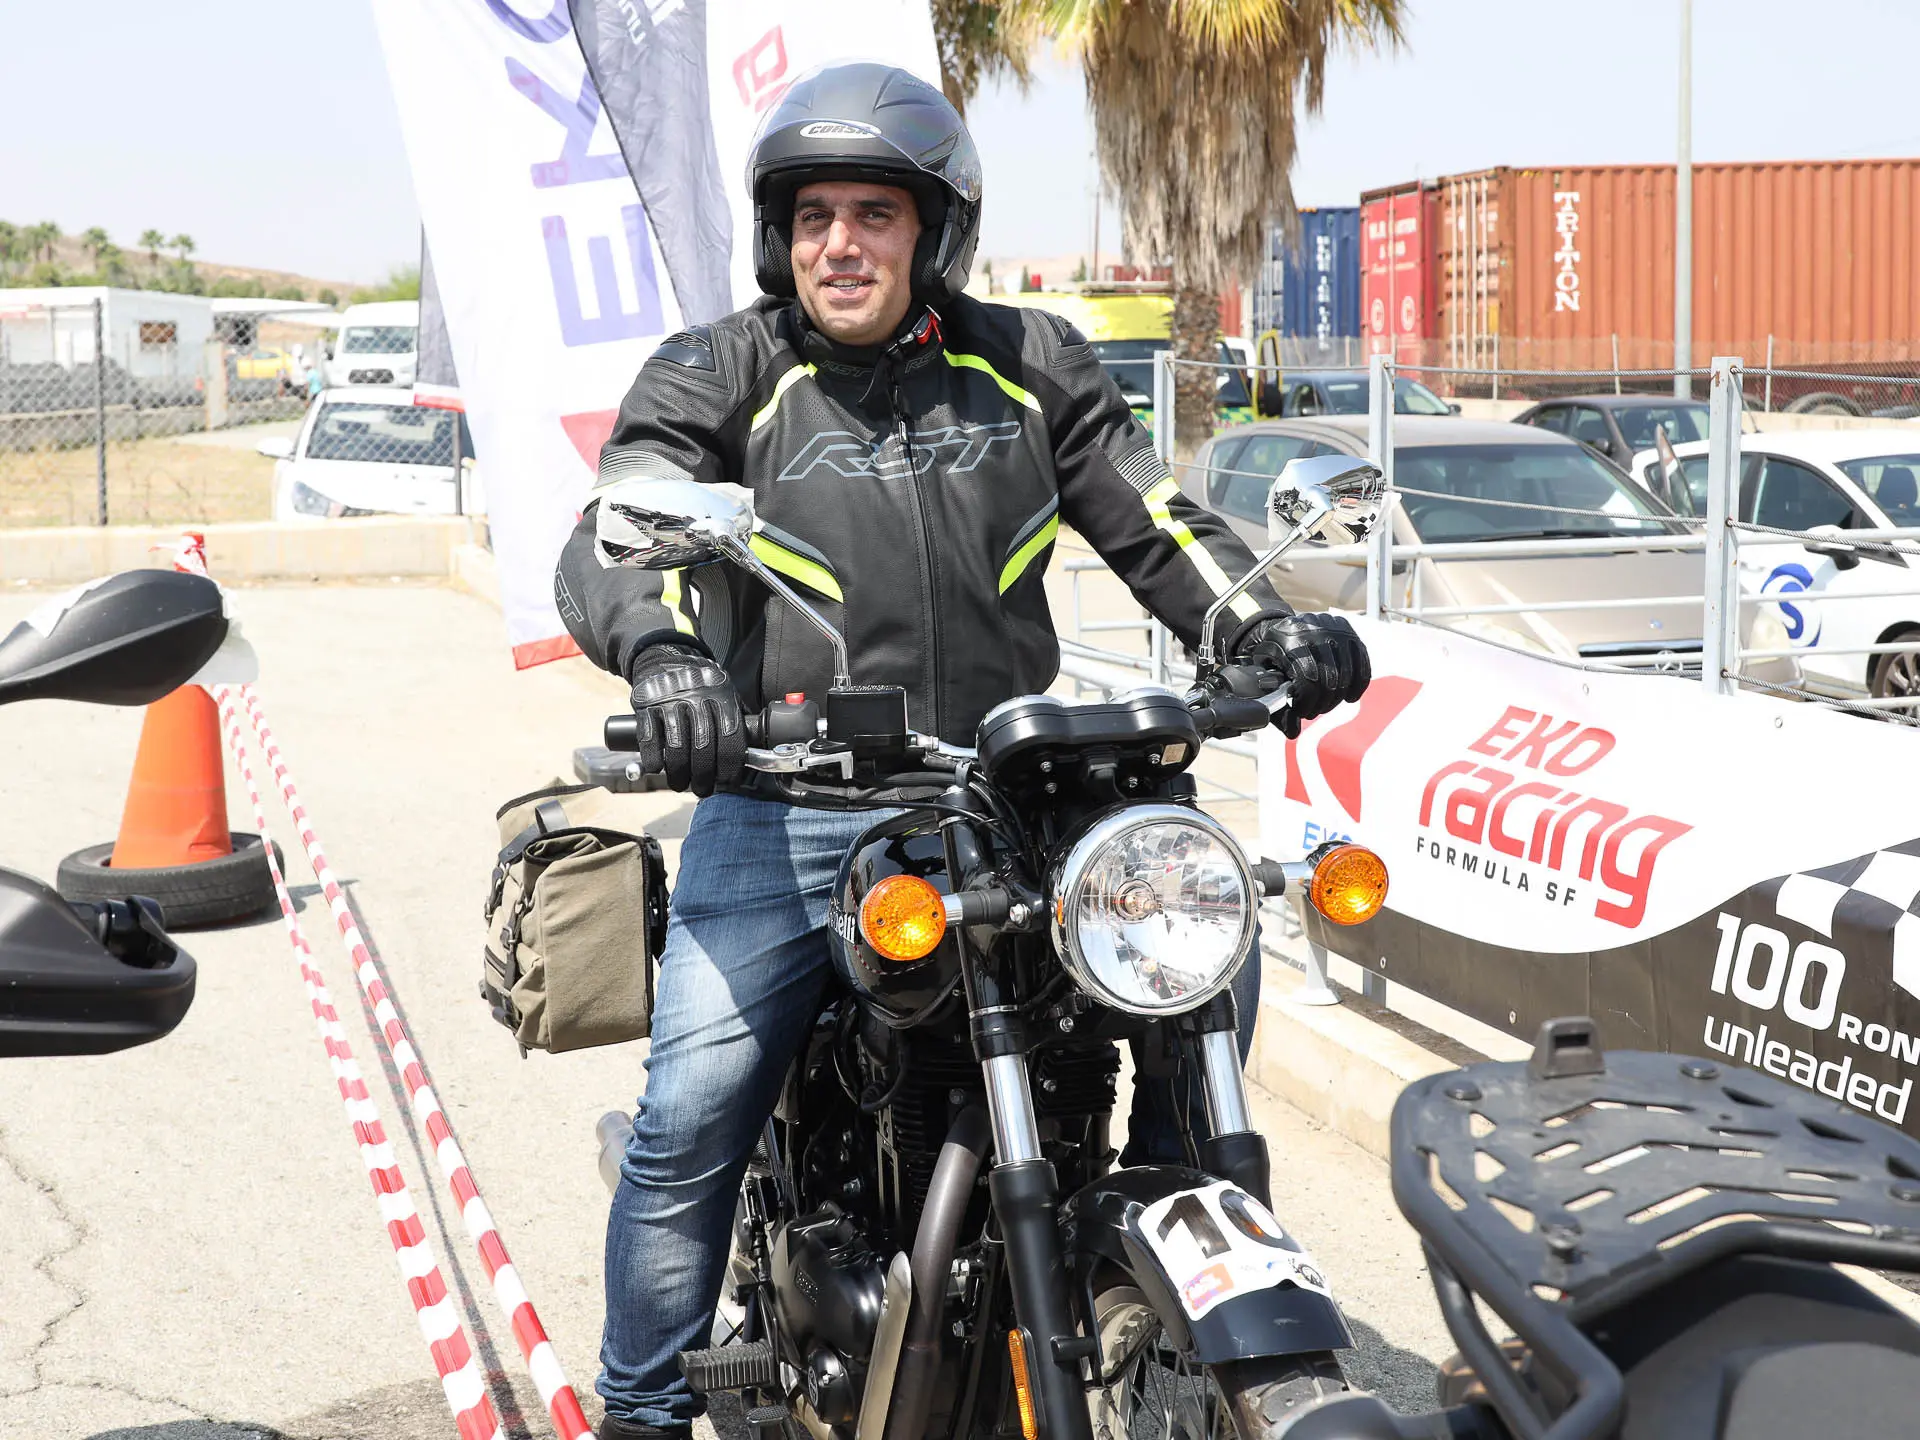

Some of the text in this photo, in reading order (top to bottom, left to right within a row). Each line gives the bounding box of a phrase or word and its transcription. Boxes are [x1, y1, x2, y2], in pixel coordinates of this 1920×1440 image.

[1554, 192, 1580, 312] TRITON
[776, 420, 1022, 482] RST
[554, 559, 584, 623] ST
[1467, 705, 1617, 777] EKO
[1416, 836, 1578, 907] FORMULA SF
[1418, 759, 1696, 929] racing
[1710, 911, 1920, 1066] 100 RON
[1703, 1015, 1914, 1125] unleaded
[1157, 1188, 1305, 1260] 10
